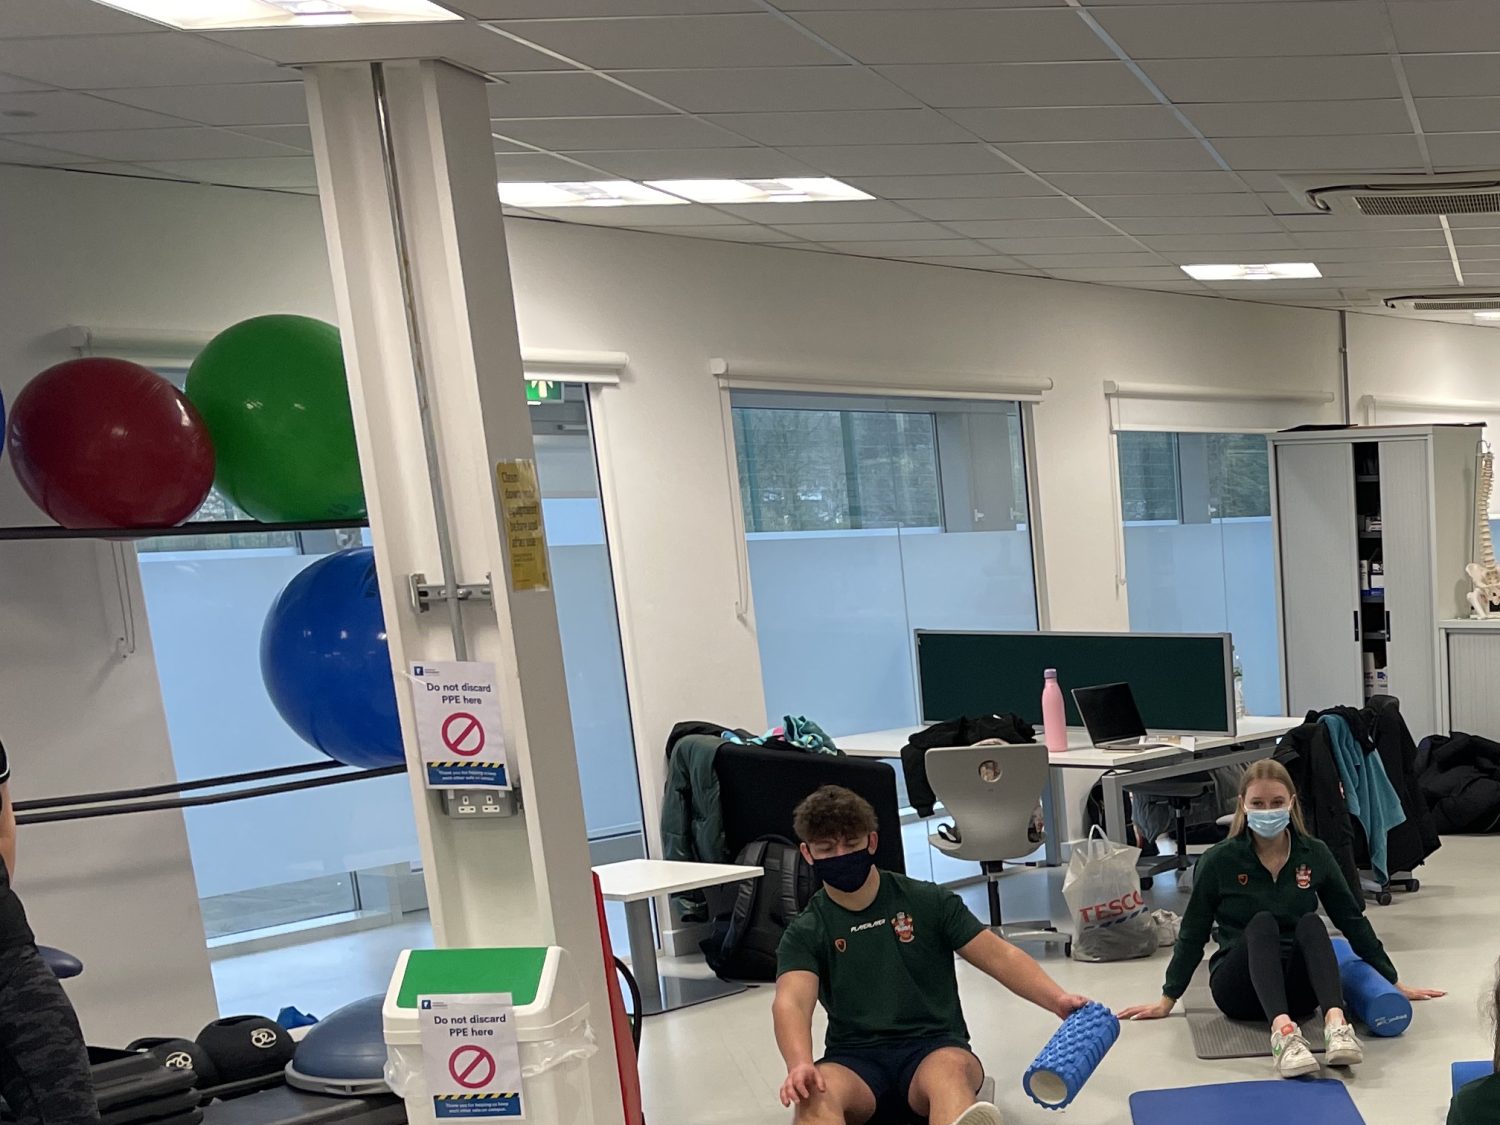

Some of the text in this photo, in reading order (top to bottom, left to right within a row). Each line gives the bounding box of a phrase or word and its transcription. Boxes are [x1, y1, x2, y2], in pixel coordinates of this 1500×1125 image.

[426, 682, 492, 693] Do not discard
[441, 695, 482, 705] PPE here
[434, 1013, 507, 1025] Do not discard
[449, 1027, 494, 1037] PPE here
